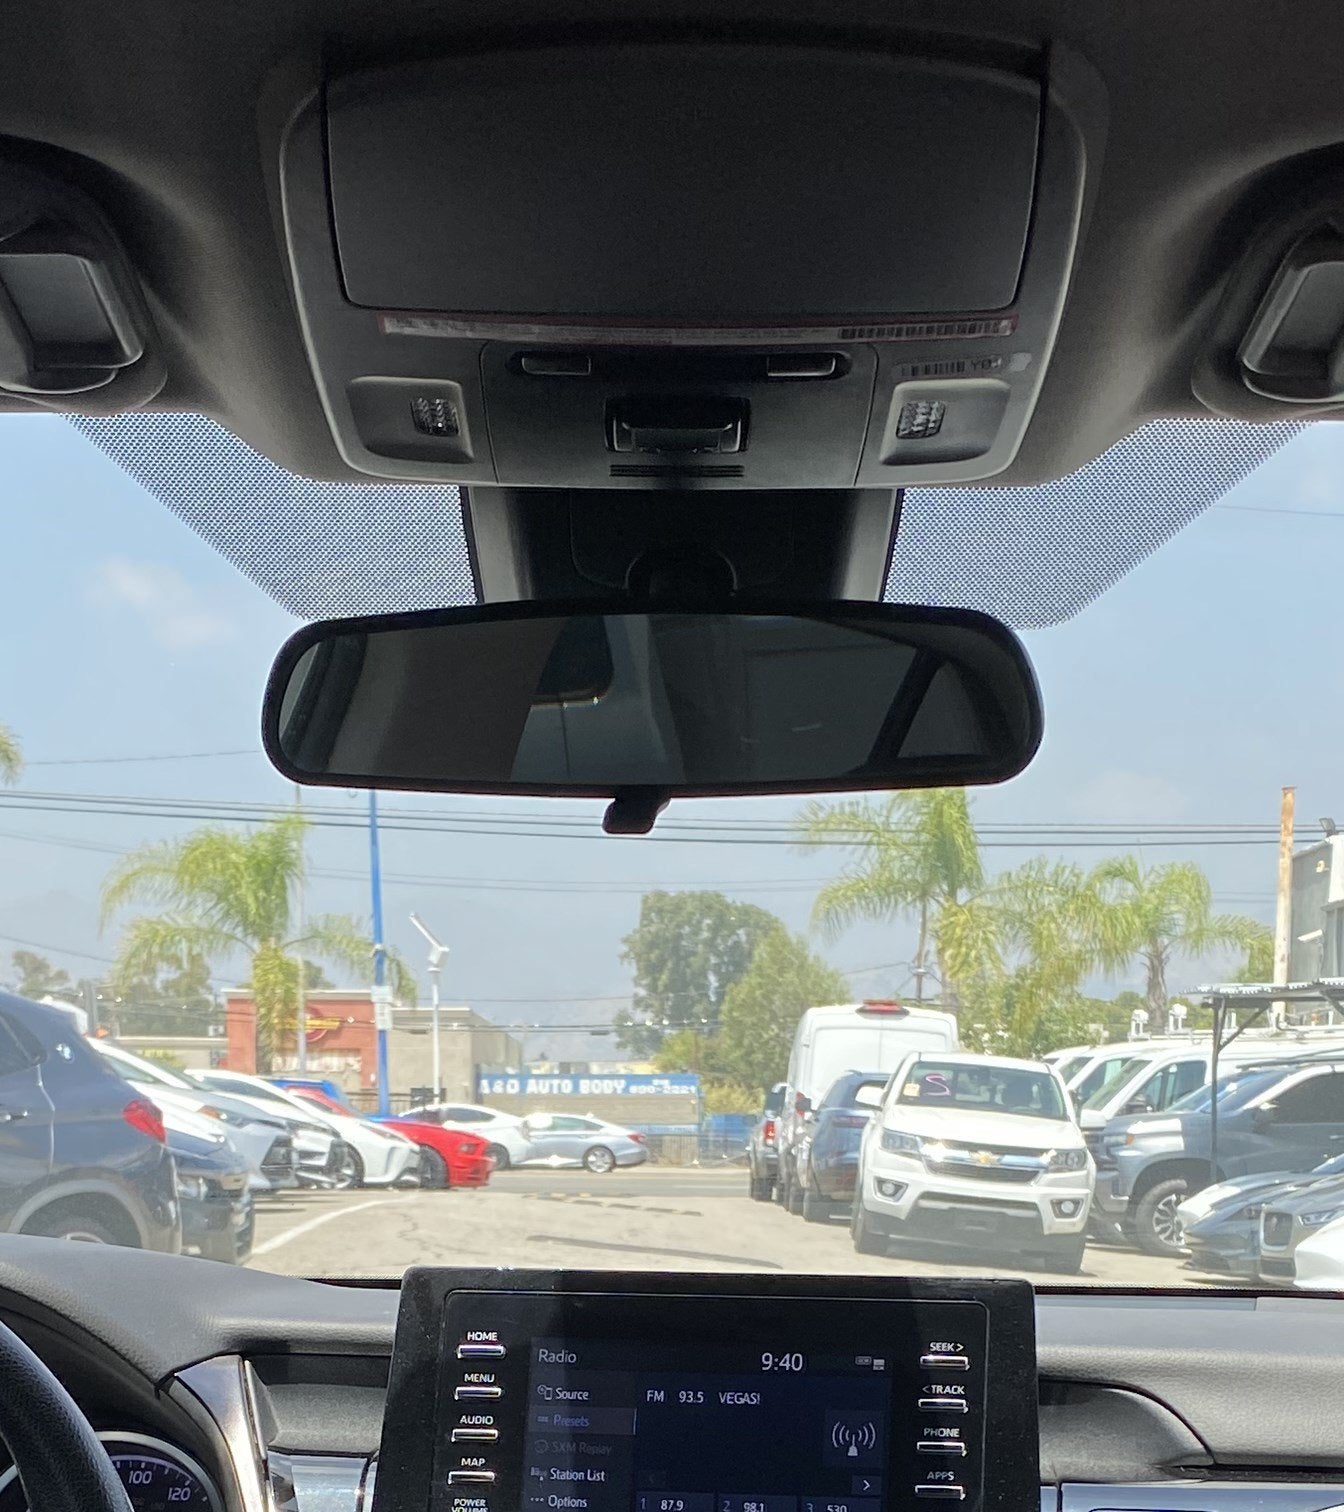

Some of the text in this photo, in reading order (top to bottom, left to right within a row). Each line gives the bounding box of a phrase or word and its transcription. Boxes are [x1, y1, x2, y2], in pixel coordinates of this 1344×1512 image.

[526, 1079, 573, 1094] AUTO
[579, 1079, 625, 1094] BODY
[467, 1331, 498, 1341] HOME
[929, 1341, 955, 1351] SEEK
[538, 1349, 803, 1371] Radio 9:40
[464, 1373, 495, 1383] MENU
[555, 1387, 589, 1400] Source
[646, 1390, 665, 1402] FM
[678, 1391, 704, 1403] 93.5
[931, 1385, 965, 1395] TRACK
[460, 1415, 494, 1425] AUDIO
[553, 1413, 590, 1427] Presets
[923, 1428, 960, 1438] PHONE
[460, 1457, 486, 1467] MAP
[128, 1471, 153, 1484] 100
[549, 1467, 606, 1482] Station List
[926, 1471, 955, 1480] APPS
[167, 1487, 191, 1501] 120
[453, 1498, 486, 1507] POWER
[547, 1494, 588, 1509] Options
[660, 1499, 684, 1512] 87.9
